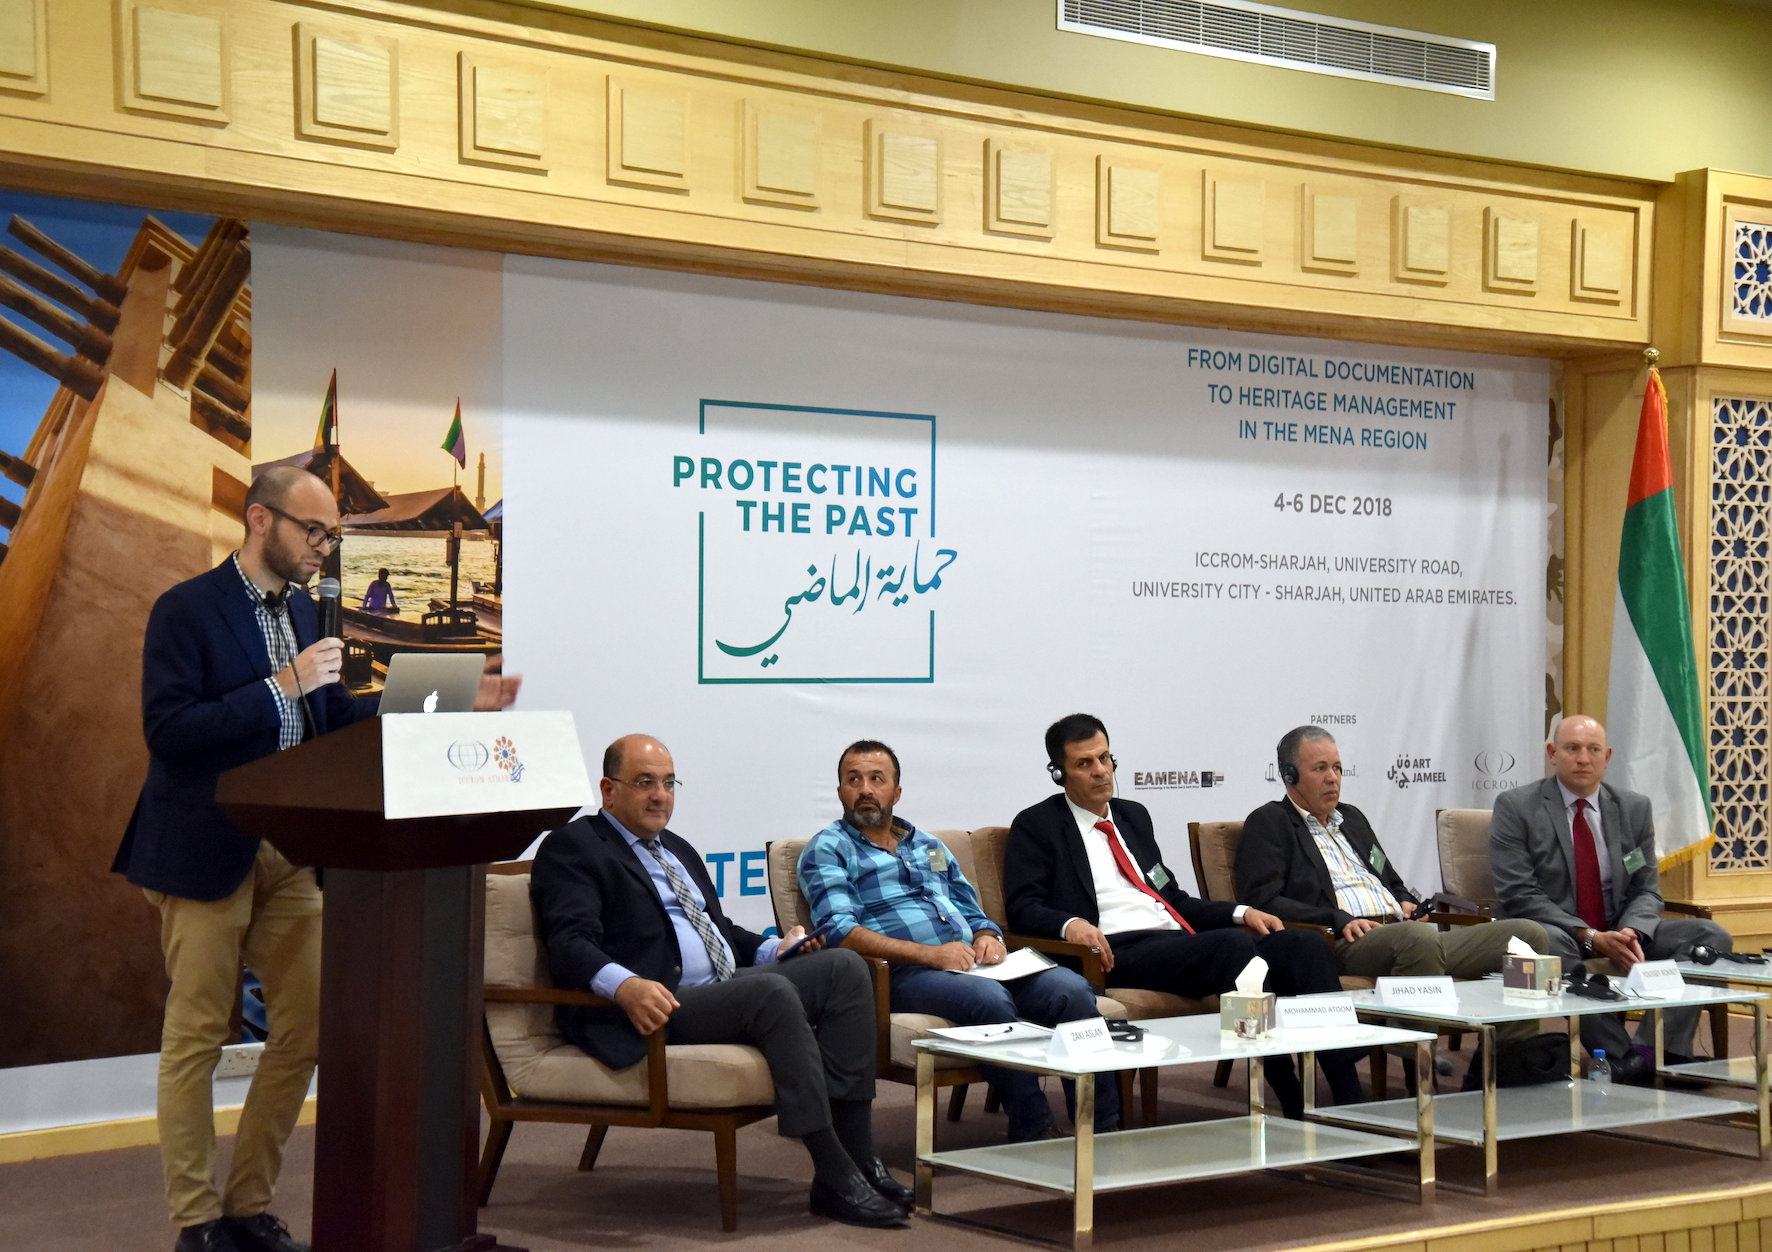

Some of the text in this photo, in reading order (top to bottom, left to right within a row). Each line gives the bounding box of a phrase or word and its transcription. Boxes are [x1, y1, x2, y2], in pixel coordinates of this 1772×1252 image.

[1188, 349, 1474, 390] FROM DIGITAL DOCUMENTATION
[1208, 384, 1456, 420] TO HERITAGE MANAGEMENT
[1239, 420, 1427, 450] IN THE MENA REGION
[673, 456, 917, 498] PROTECTING
[1274, 493, 1392, 516] 4-6 DEC 2018
[736, 500, 918, 538] THE PAST
[1195, 551, 1463, 577] ICCROM-SHARJAH, UNIVERSITY ROAD,
[715, 539, 958, 668] حماية الماضي
[1133, 582, 1223, 599] UNIVERSITY
[1228, 584, 1261, 600] CITY
[1275, 585, 1345, 603] SHARJAH,
[1350, 587, 1401, 603] UNITED
[1405, 588, 1444, 604] ARAB
[1448, 590, 1517, 605] EMIRATES.
[1310, 714, 1357, 725] PARTNERS
[1412, 758, 1432, 769] ART
[1134, 771, 1199, 786] EAMENA
[1412, 772, 1447, 783] JAMEEL
[1392, 986, 1442, 995] JIHAD YASIN
[1284, 1007, 1327, 1015] MOHAMMAD
[1071, 1028, 1103, 1041] ZAKI ASLAN
